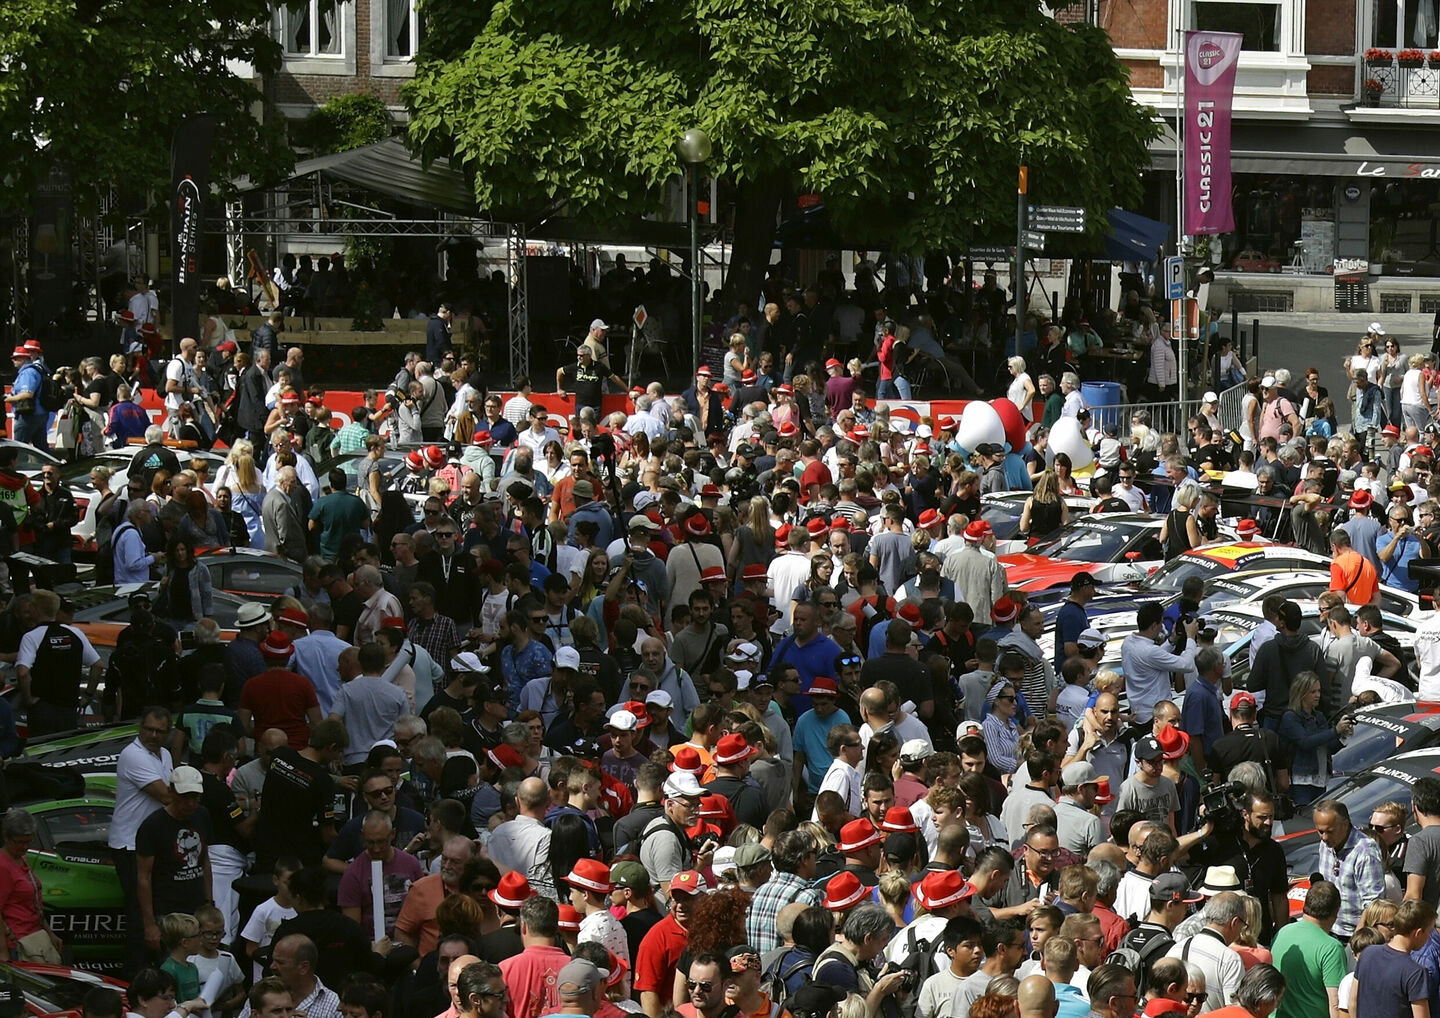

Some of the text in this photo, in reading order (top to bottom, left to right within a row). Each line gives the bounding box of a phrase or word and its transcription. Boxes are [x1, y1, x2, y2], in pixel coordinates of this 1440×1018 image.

[1199, 50, 1221, 58] CLASSIC
[1203, 57, 1212, 65] 21
[1197, 101, 1215, 127] 21
[1200, 131, 1212, 213] CLASSIC
[1357, 161, 1386, 176] Le
[179, 197, 192, 284] BLANCPAIN
[1173, 264, 1180, 283] P
[979, 498, 1017, 509] BLANCPAIN
[1073, 520, 1118, 532] BLANCPAIN
[1179, 554, 1218, 570] BLANCPAIN
[1213, 580, 1252, 595] BLANCPAIN
[1356, 713, 1410, 734] BLANCPAIN
